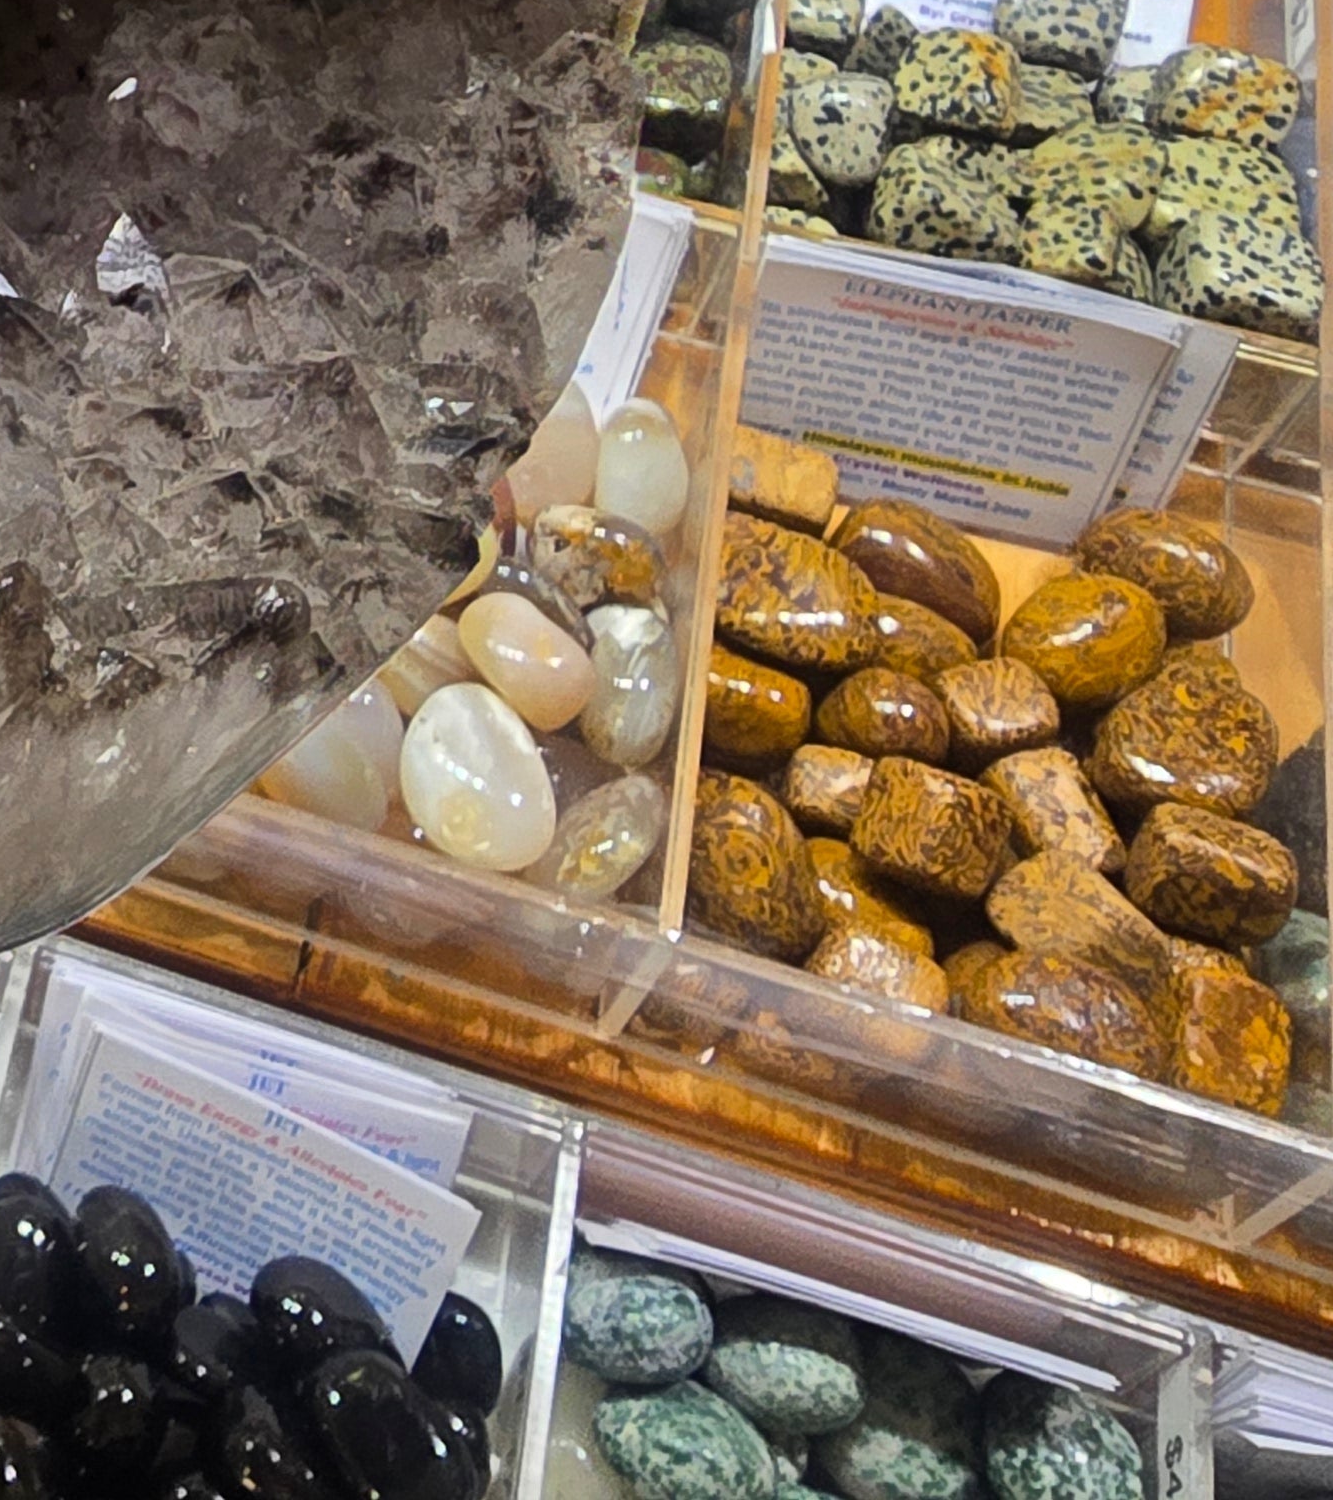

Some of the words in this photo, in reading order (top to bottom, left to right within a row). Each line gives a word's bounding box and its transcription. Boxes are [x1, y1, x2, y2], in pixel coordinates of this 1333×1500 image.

[843, 278, 980, 317] ELEPHANT
[977, 304, 1073, 335] JASPER
[262, 1108, 302, 1139] JET
